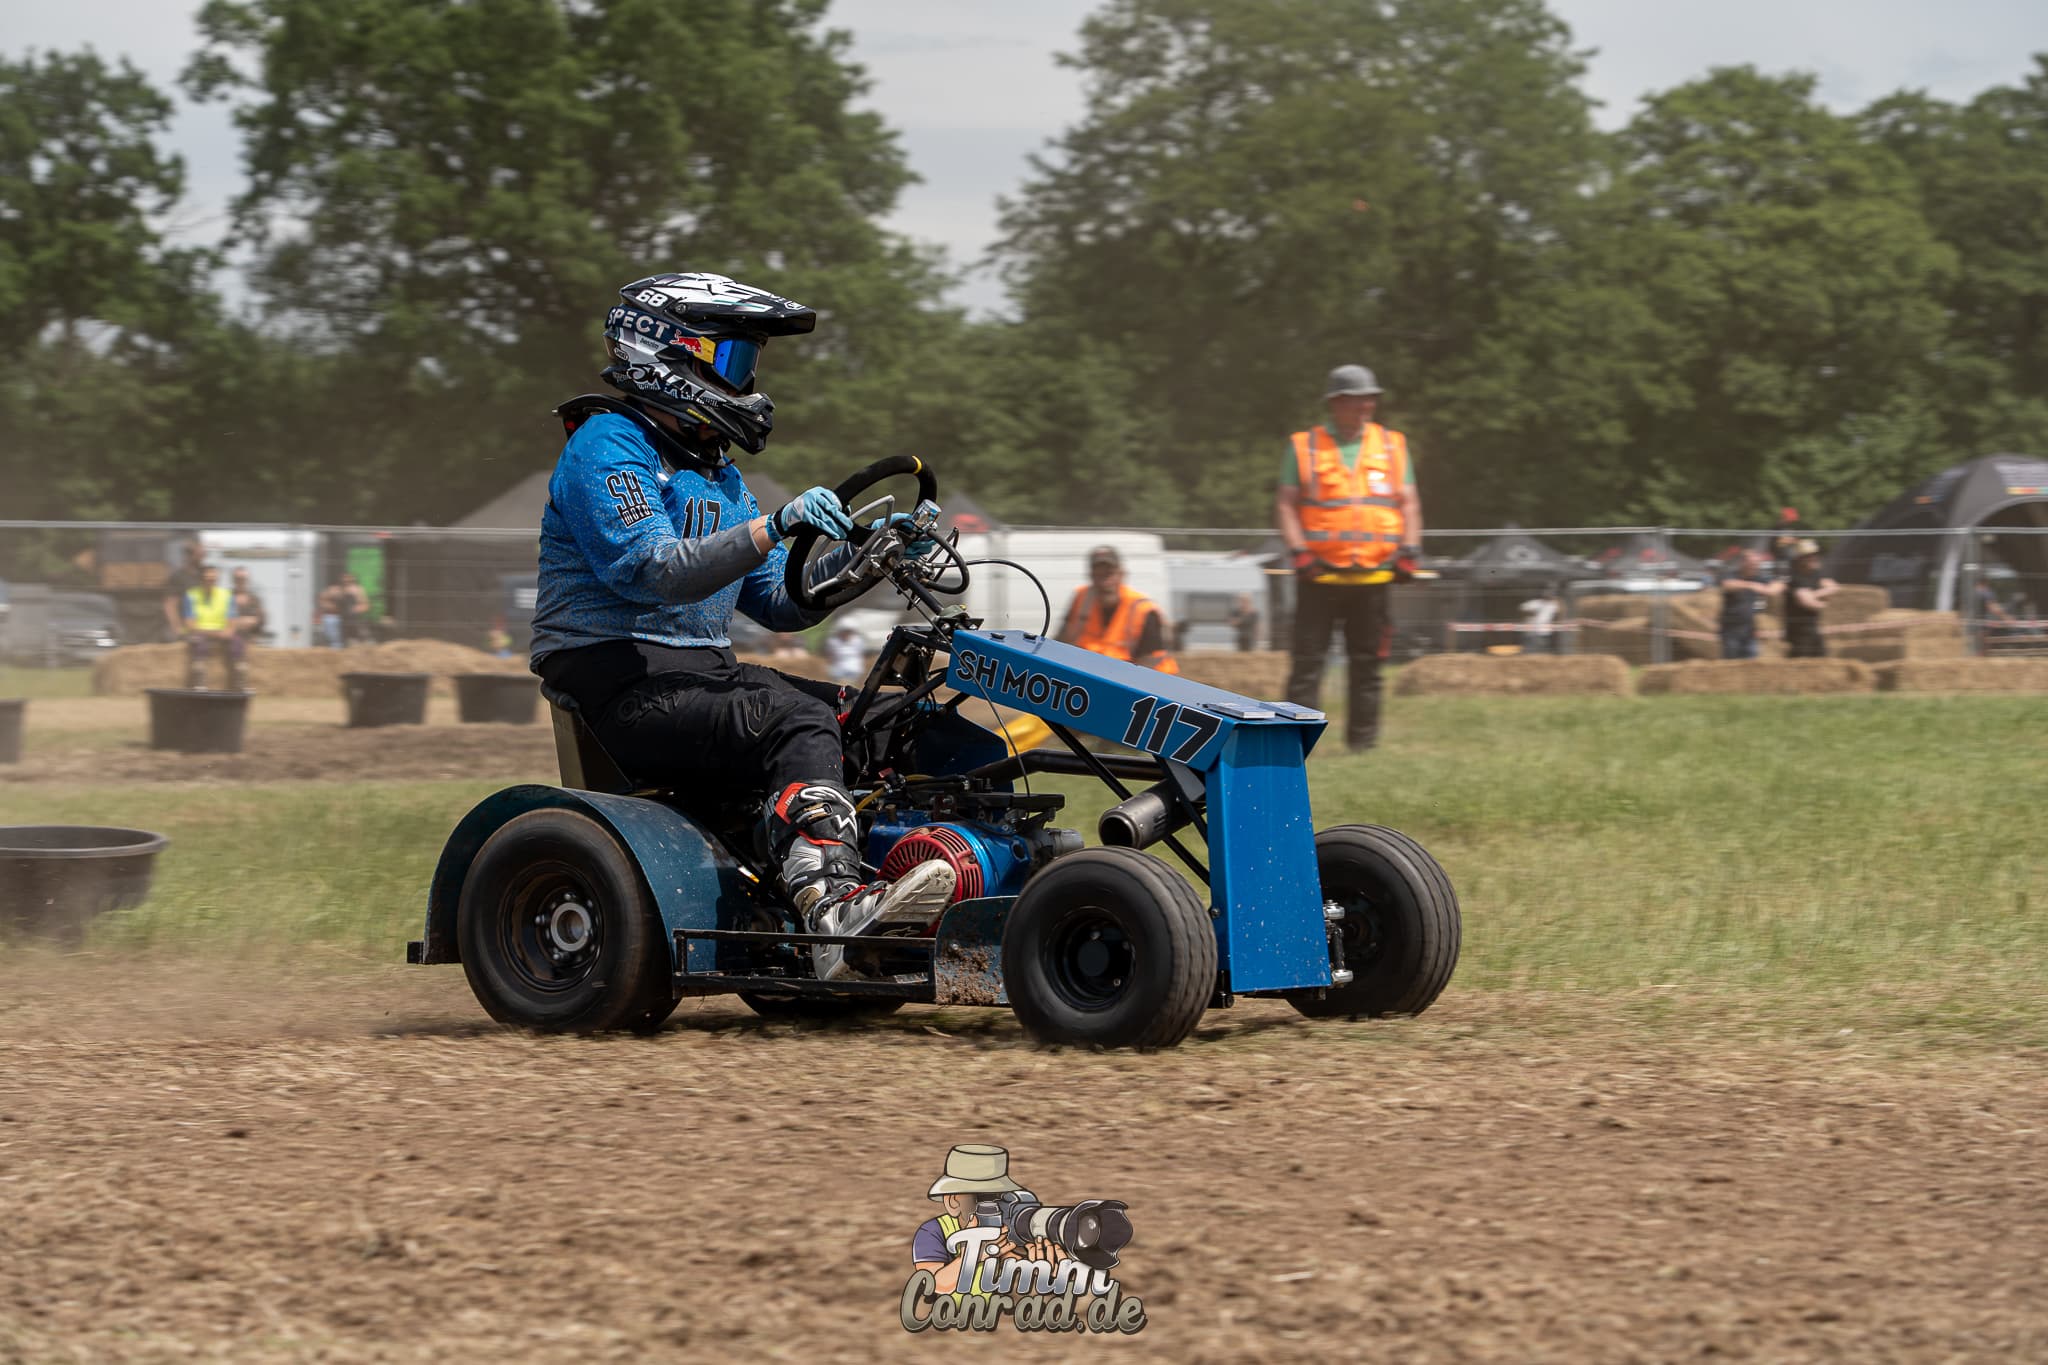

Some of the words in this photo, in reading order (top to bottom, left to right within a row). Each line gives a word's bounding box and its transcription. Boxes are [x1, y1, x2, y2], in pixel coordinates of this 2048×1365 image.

[635, 289, 669, 308] 68
[605, 470, 648, 511] SH
[622, 504, 652, 526] MOTO
[682, 497, 721, 540] 117
[955, 650, 998, 689] SH
[1002, 663, 1090, 718] MOTO
[1121, 695, 1223, 764] 117
